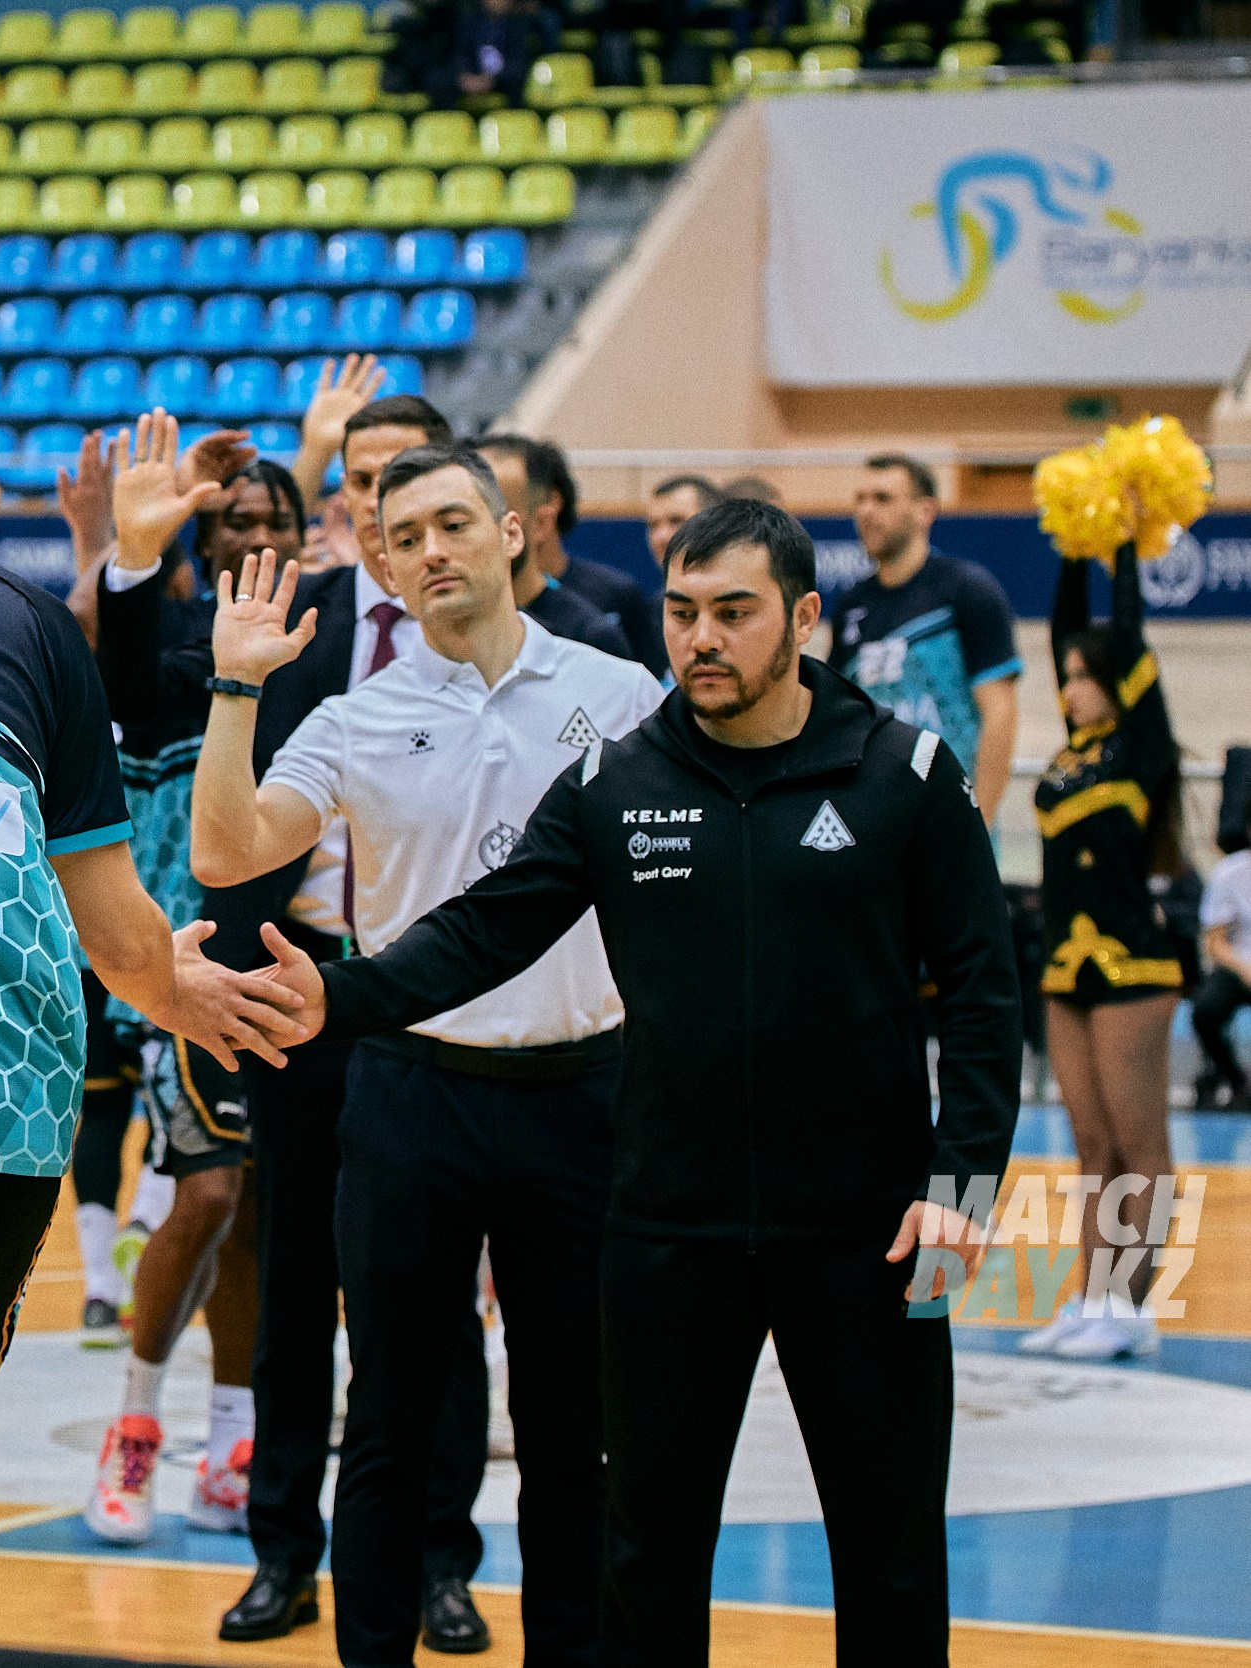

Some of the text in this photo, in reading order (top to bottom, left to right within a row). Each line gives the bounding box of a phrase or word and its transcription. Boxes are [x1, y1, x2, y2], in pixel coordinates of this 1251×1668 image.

[622, 808, 703, 824] KELME
[632, 866, 693, 883] Sport Qory
